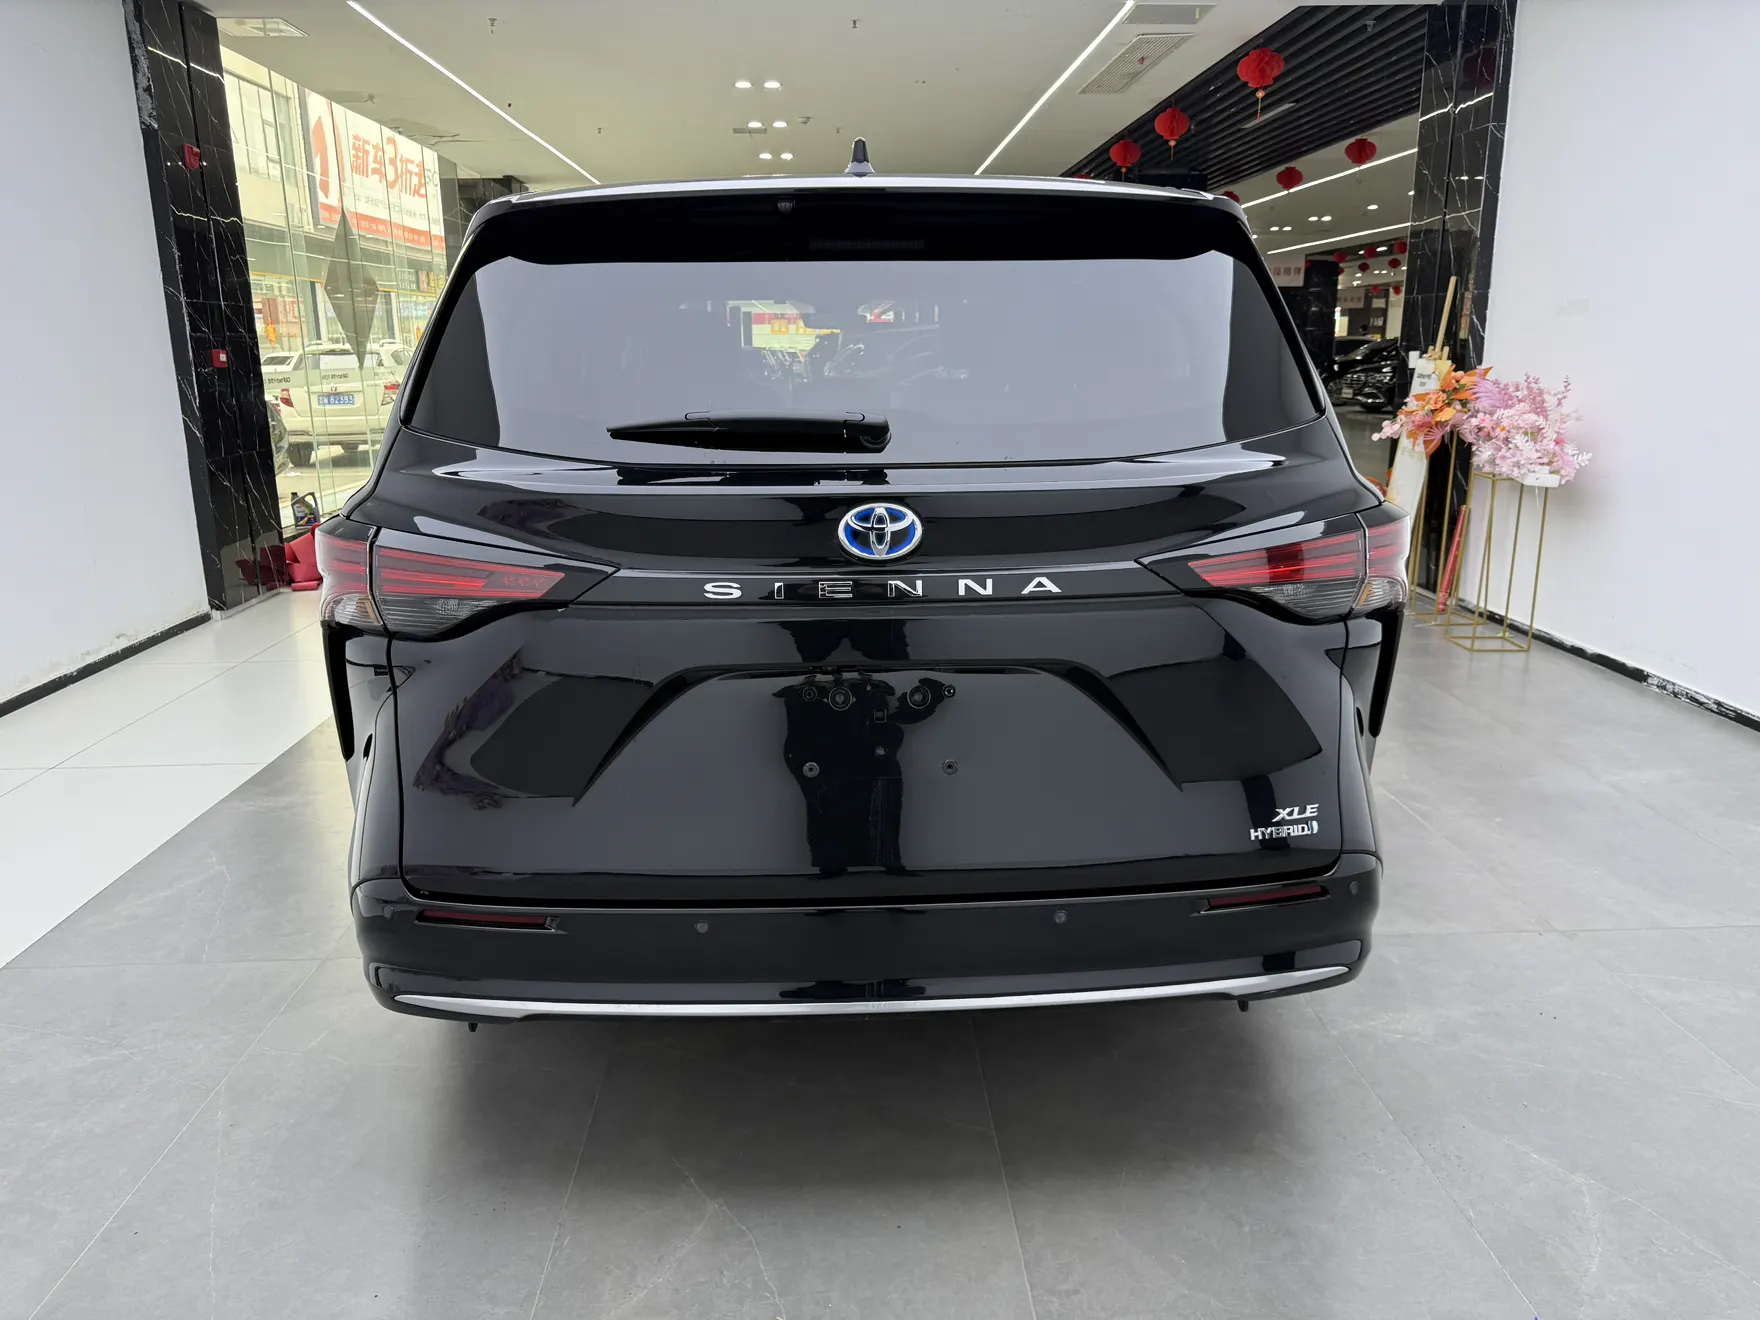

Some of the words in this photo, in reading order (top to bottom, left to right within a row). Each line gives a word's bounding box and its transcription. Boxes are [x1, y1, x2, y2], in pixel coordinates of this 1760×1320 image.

[703, 576, 1062, 599] SIENNA
[1271, 803, 1319, 822] XLE
[1250, 823, 1309, 840] HYBRID
